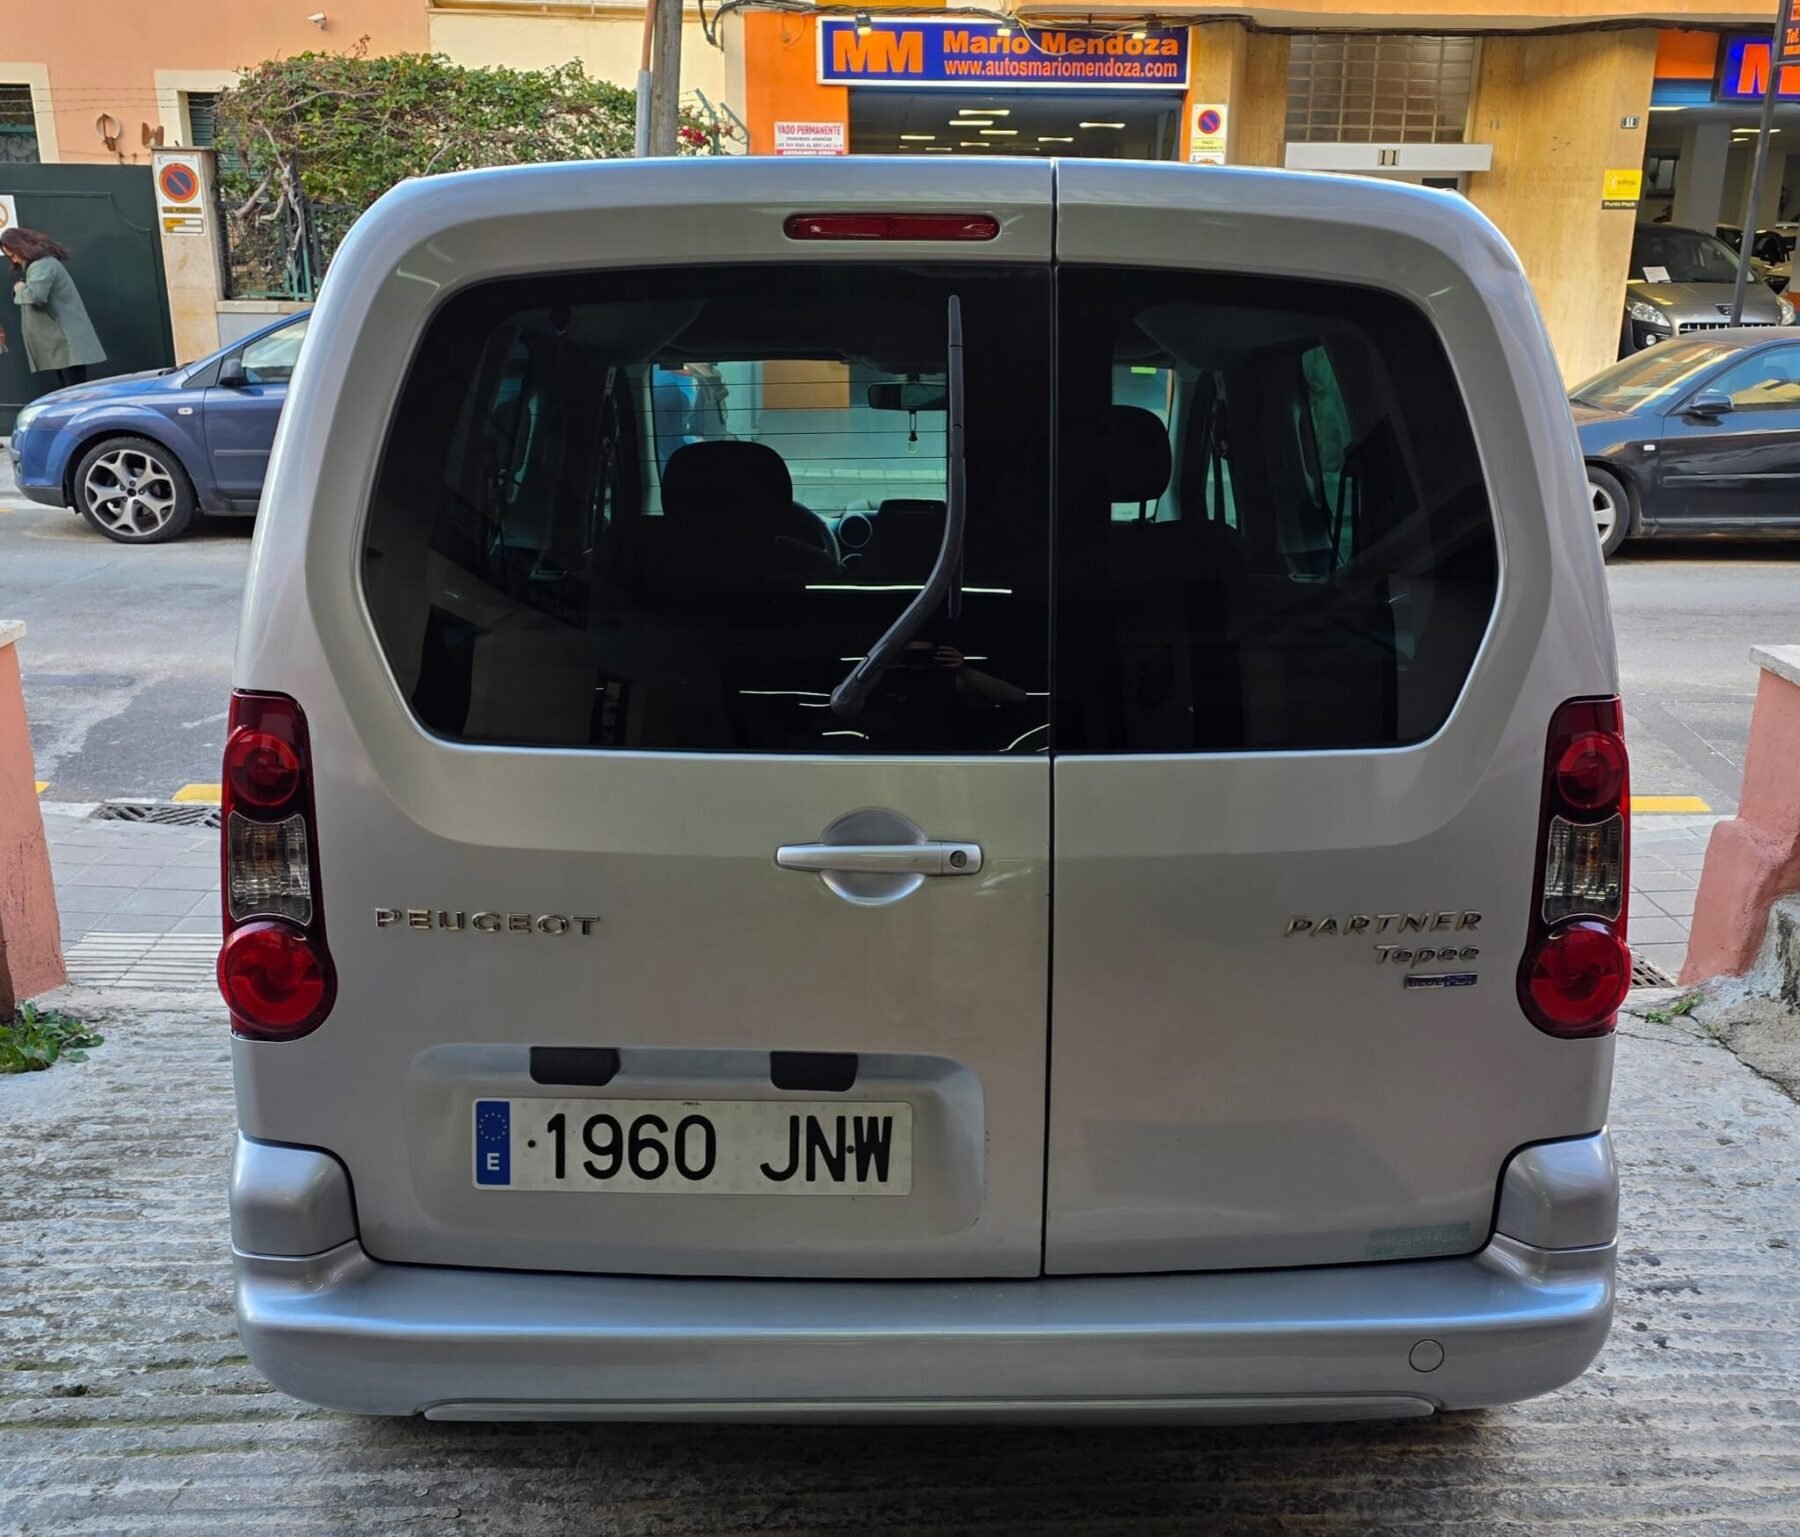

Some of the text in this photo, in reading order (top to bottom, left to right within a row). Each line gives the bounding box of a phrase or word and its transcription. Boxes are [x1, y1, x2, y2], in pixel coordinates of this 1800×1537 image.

[833, 30, 923, 73] MM
[943, 30, 1179, 56] Mario Mendoza
[944, 58, 1178, 78] www.autosmariomendoza.com
[777, 124, 842, 136] VADO PERMANENTE
[1380, 150, 1397, 166] 11
[374, 907, 601, 937] PEUGEOT
[1284, 909, 1483, 938] PARTNER
[1374, 944, 1480, 968] Tepee
[547, 1112, 893, 1182] 1960 JNW
[486, 1152, 500, 1171] E
